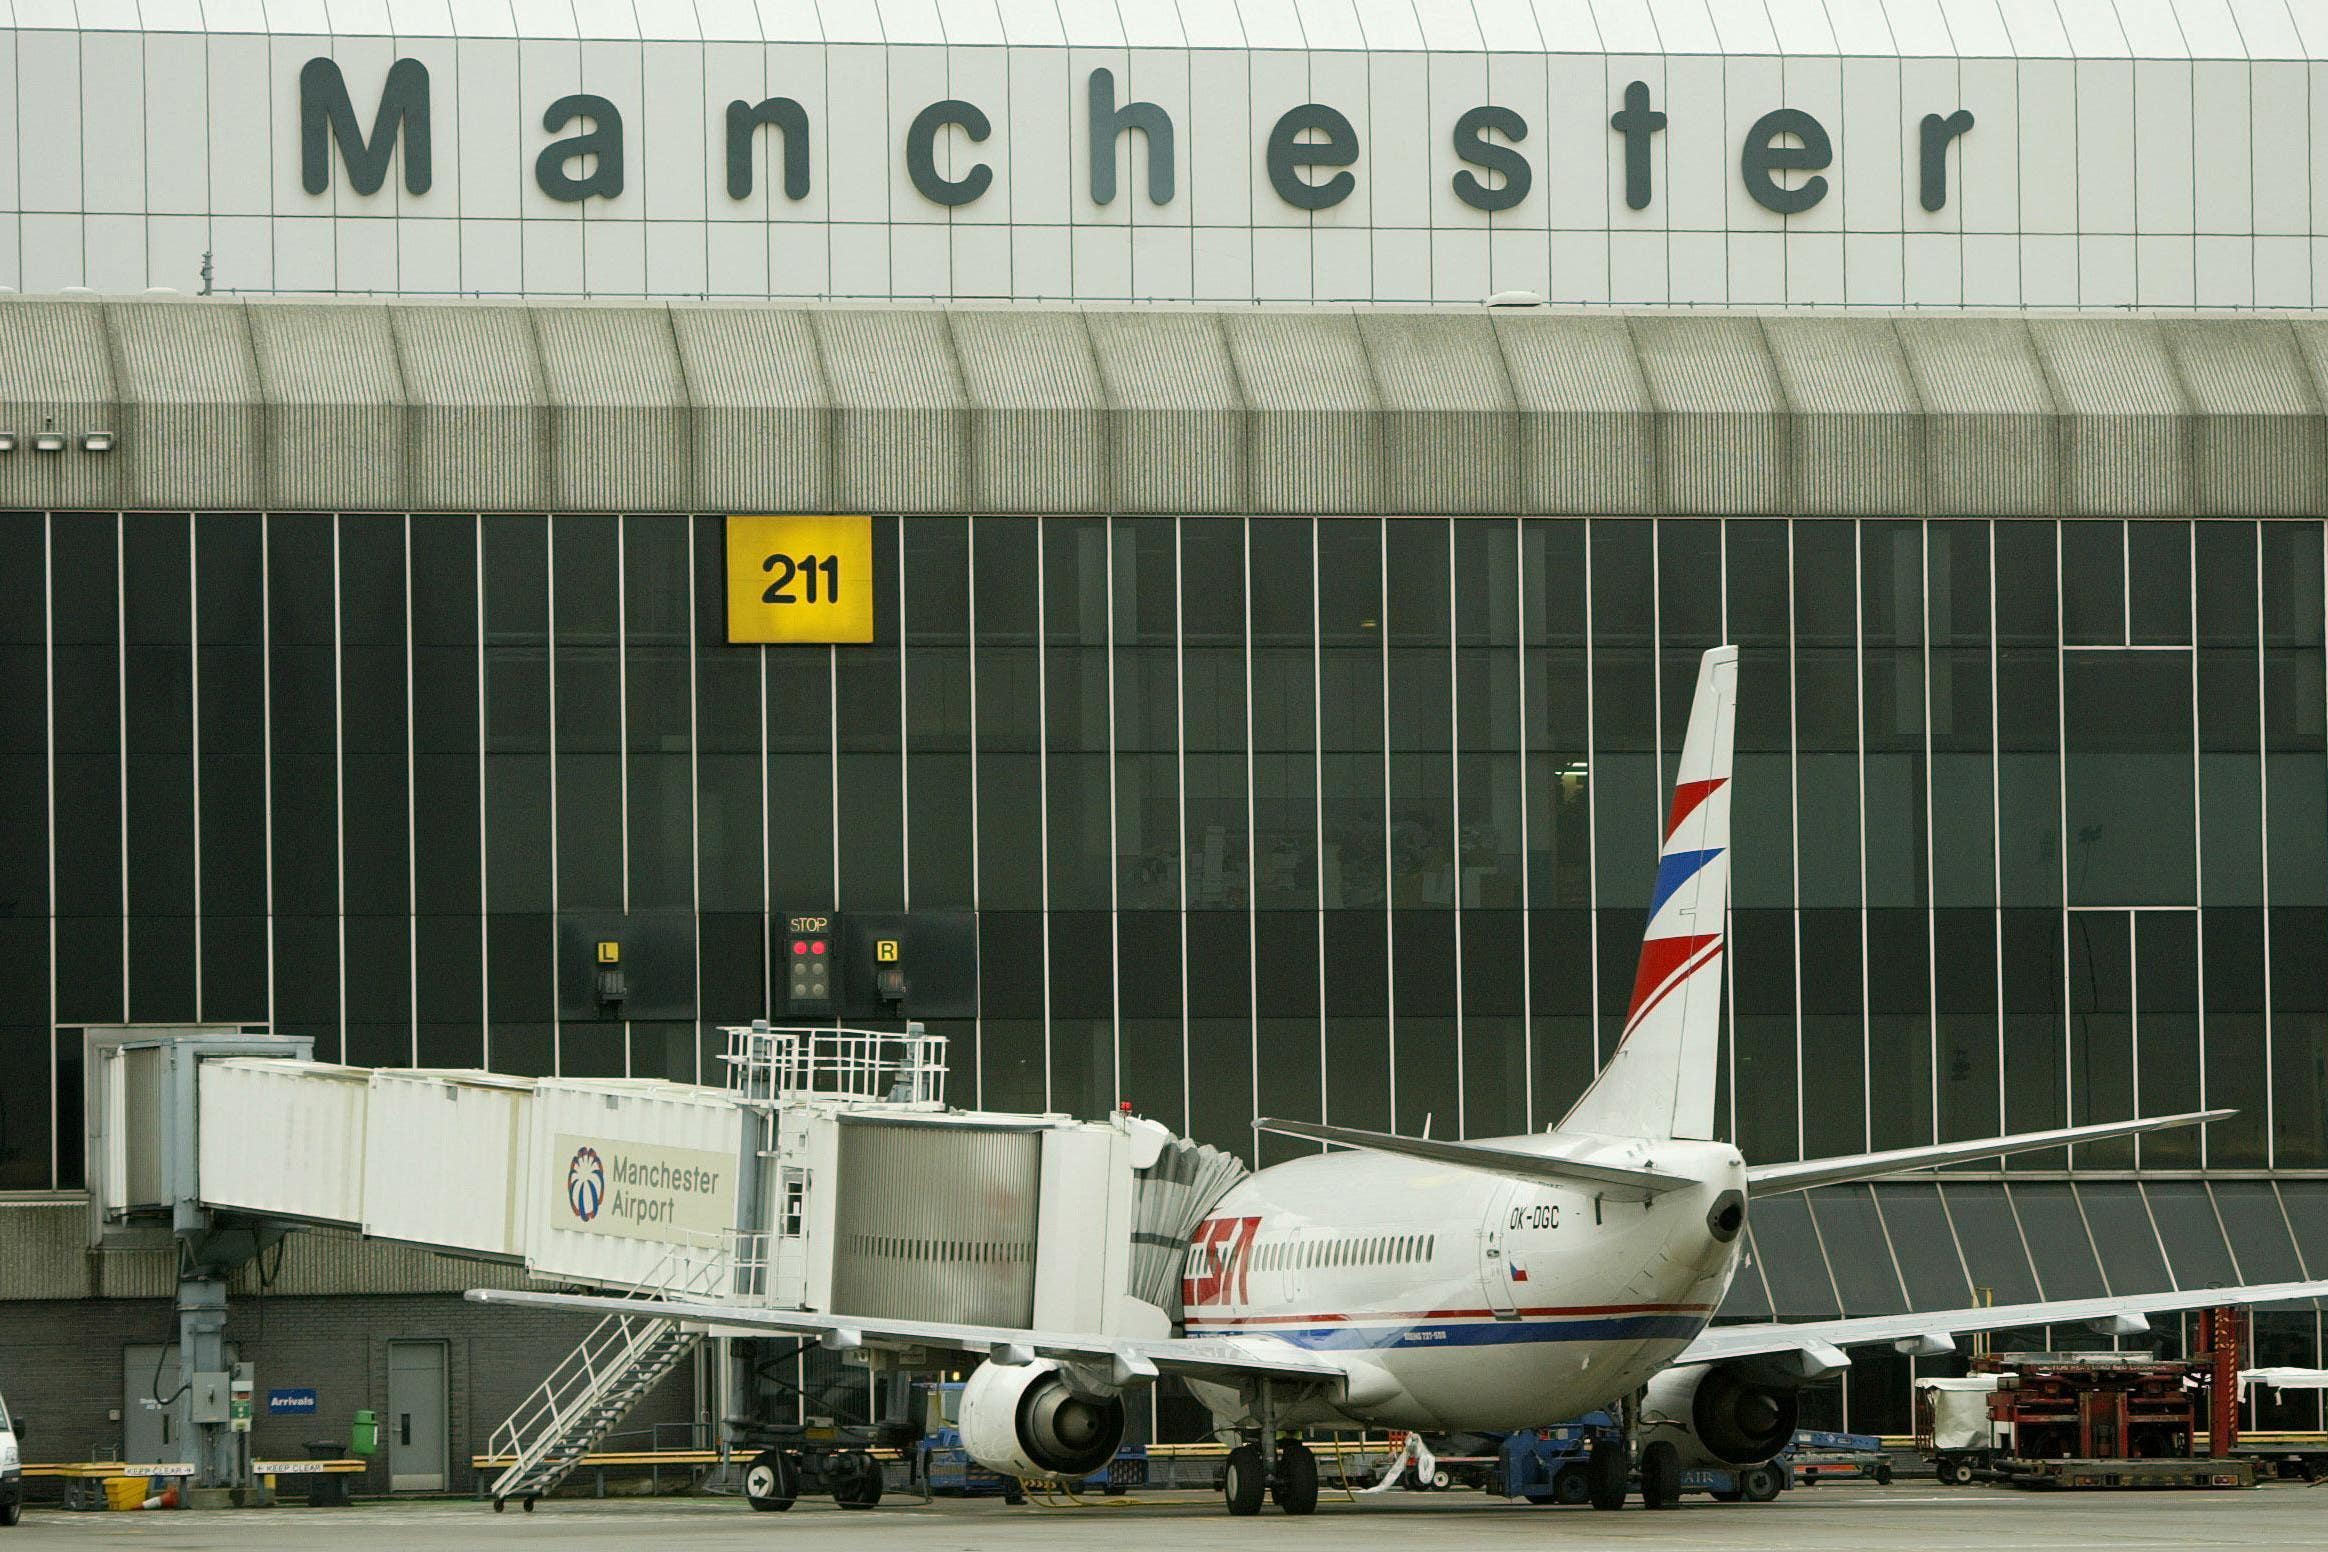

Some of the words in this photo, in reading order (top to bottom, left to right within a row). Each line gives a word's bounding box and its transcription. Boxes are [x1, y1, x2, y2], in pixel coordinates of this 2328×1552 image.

[300, 56, 1975, 214] Manchester
[761, 553, 839, 604] 211
[789, 917, 828, 932] STOP
[602, 943, 615, 960] L
[881, 942, 895, 960] R
[612, 1154, 719, 1195] Manchester
[611, 1189, 675, 1226] Airport
[1510, 1205, 1560, 1230] OK-DGC
[271, 1396, 315, 1407] Arrivals
[266, 1464, 290, 1472] KEEP
[292, 1464, 322, 1472] CLEAR
